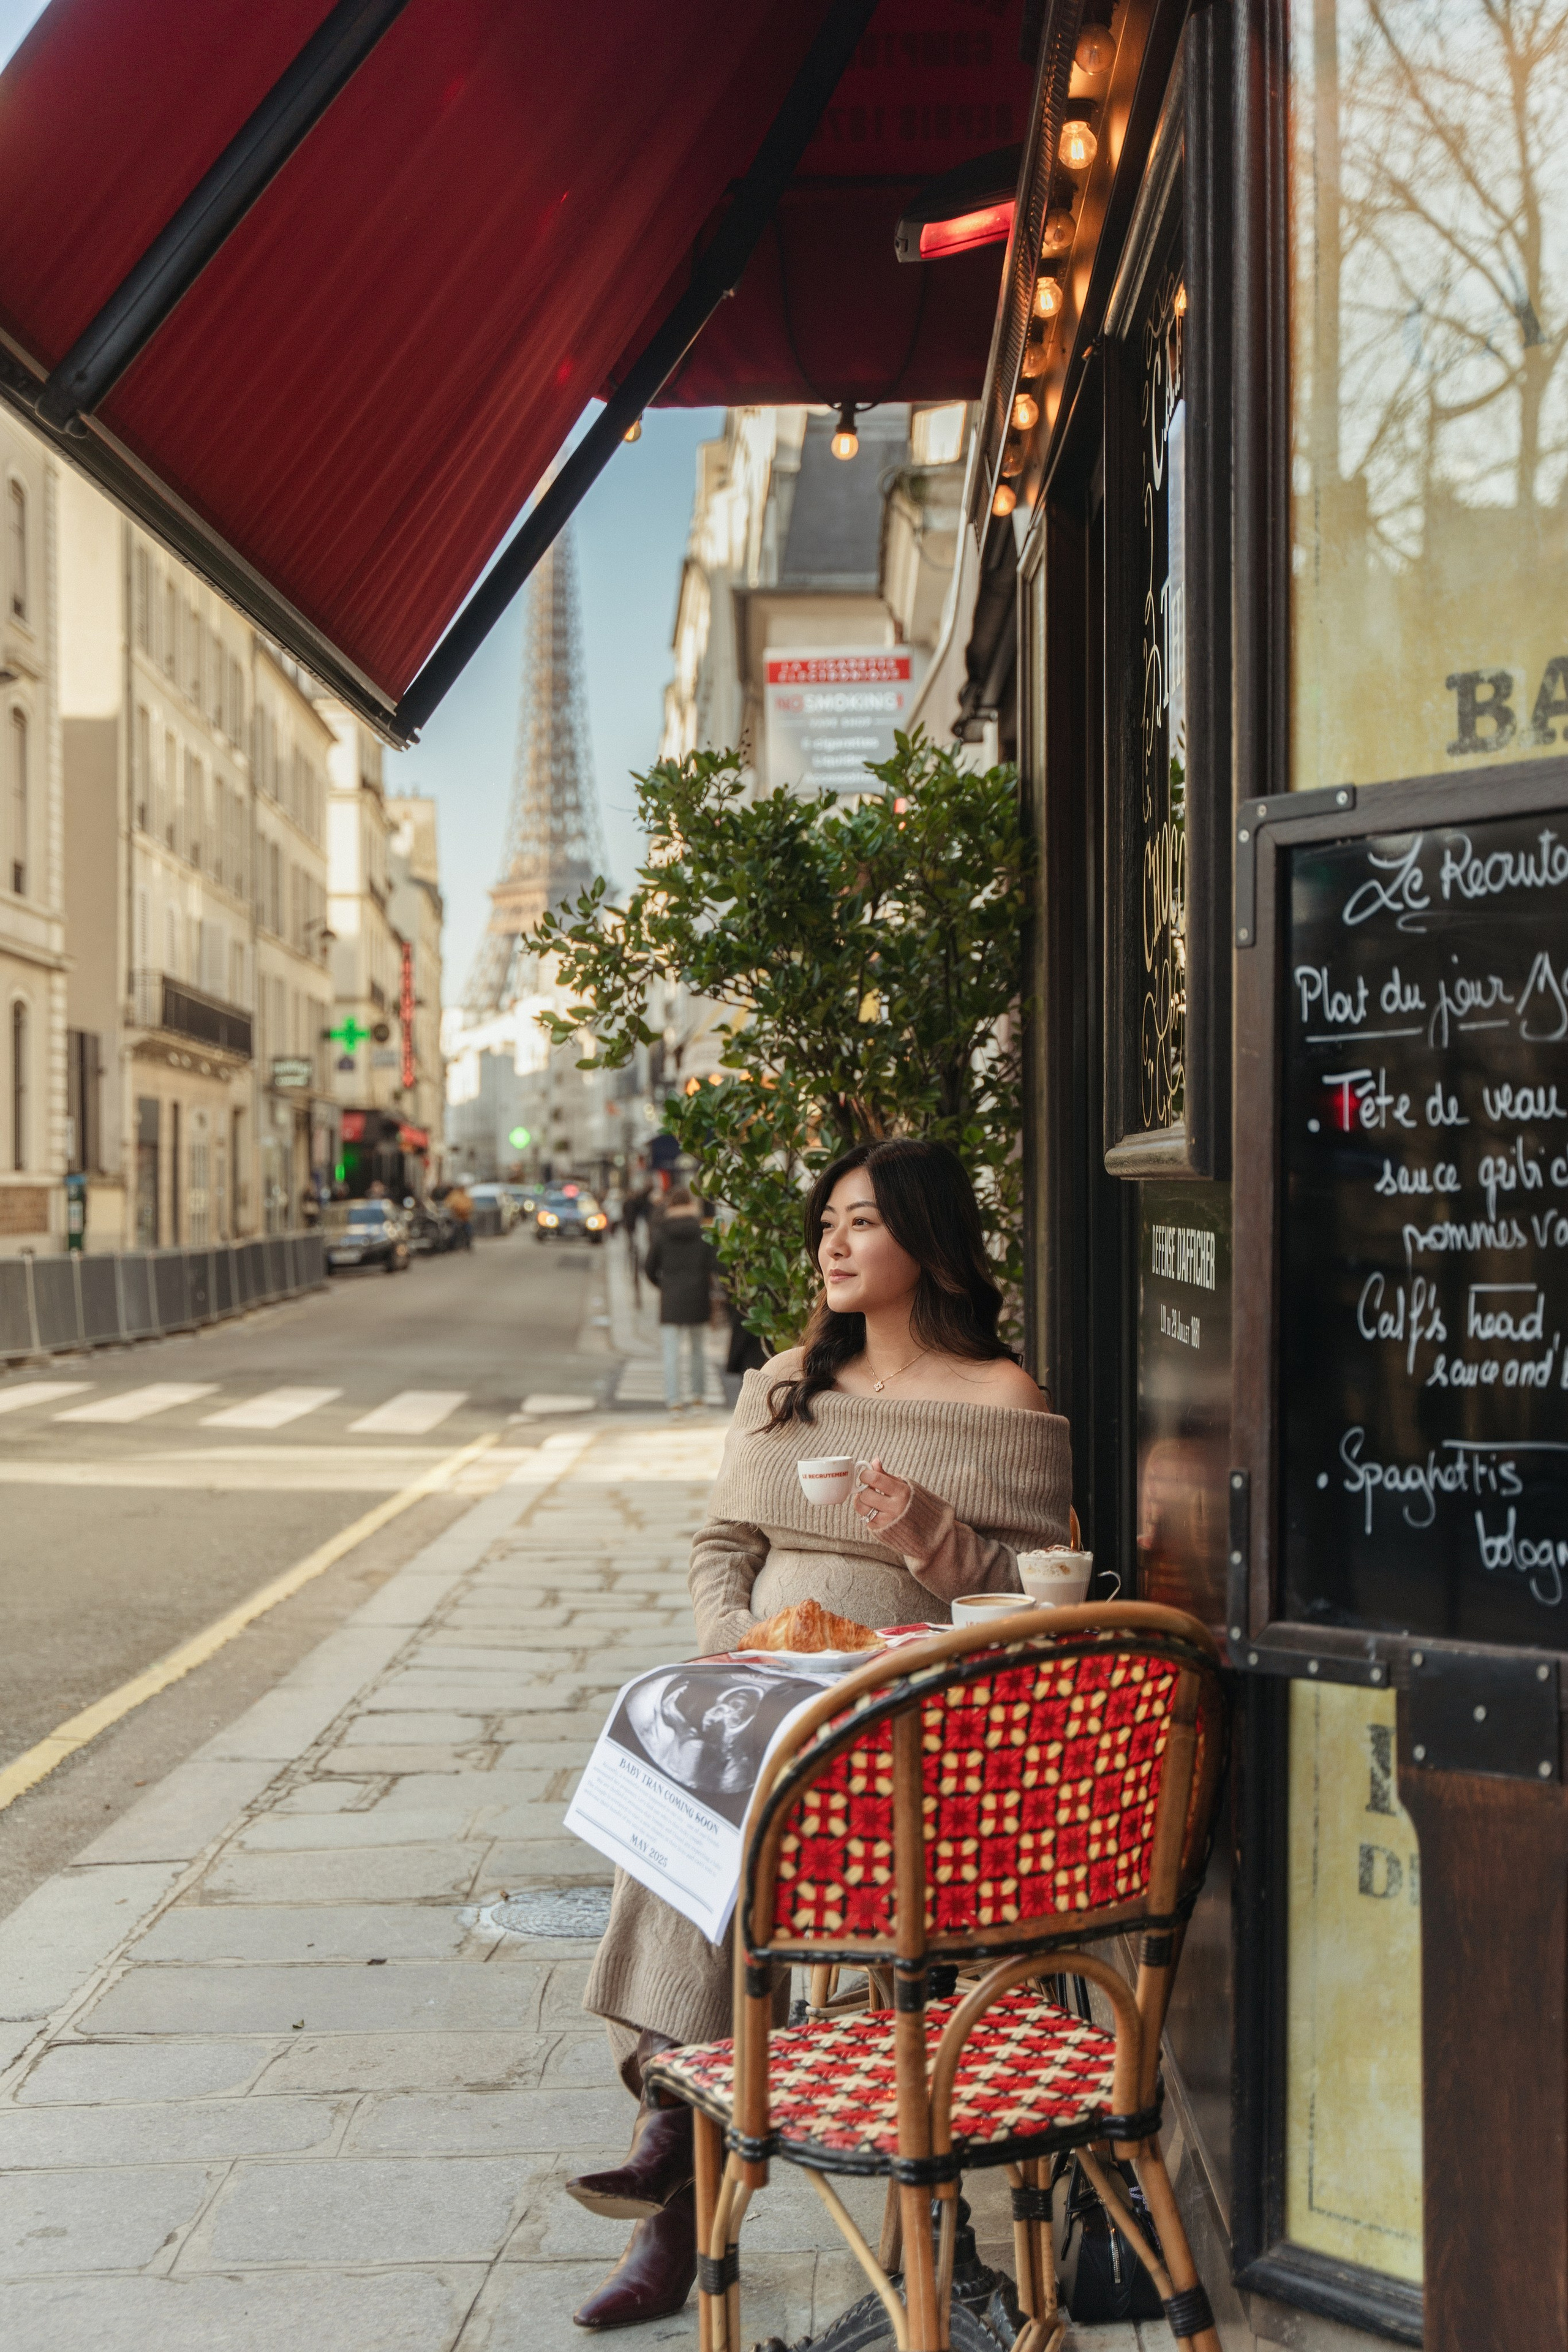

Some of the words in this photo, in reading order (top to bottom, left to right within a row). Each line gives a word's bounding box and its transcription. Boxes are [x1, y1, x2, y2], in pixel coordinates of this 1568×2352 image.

[1294, 965, 1369, 1024] Plat
[1381, 966, 1426, 1014] du
[1426, 1080, 1470, 1126] de
[1152, 1224, 1175, 1280] DEFENSE
[1357, 1271, 1448, 1374] Calf's
[1502, 1348, 1555, 1388] and
[619, 1758, 640, 1778] BABY
[642, 1773, 662, 1795] TRAN
[664, 1790, 694, 1818] COMING
[695, 1812, 720, 1835] SOON
[630, 1834, 649, 1853] MAY
[649, 1847, 669, 1868] 2025
